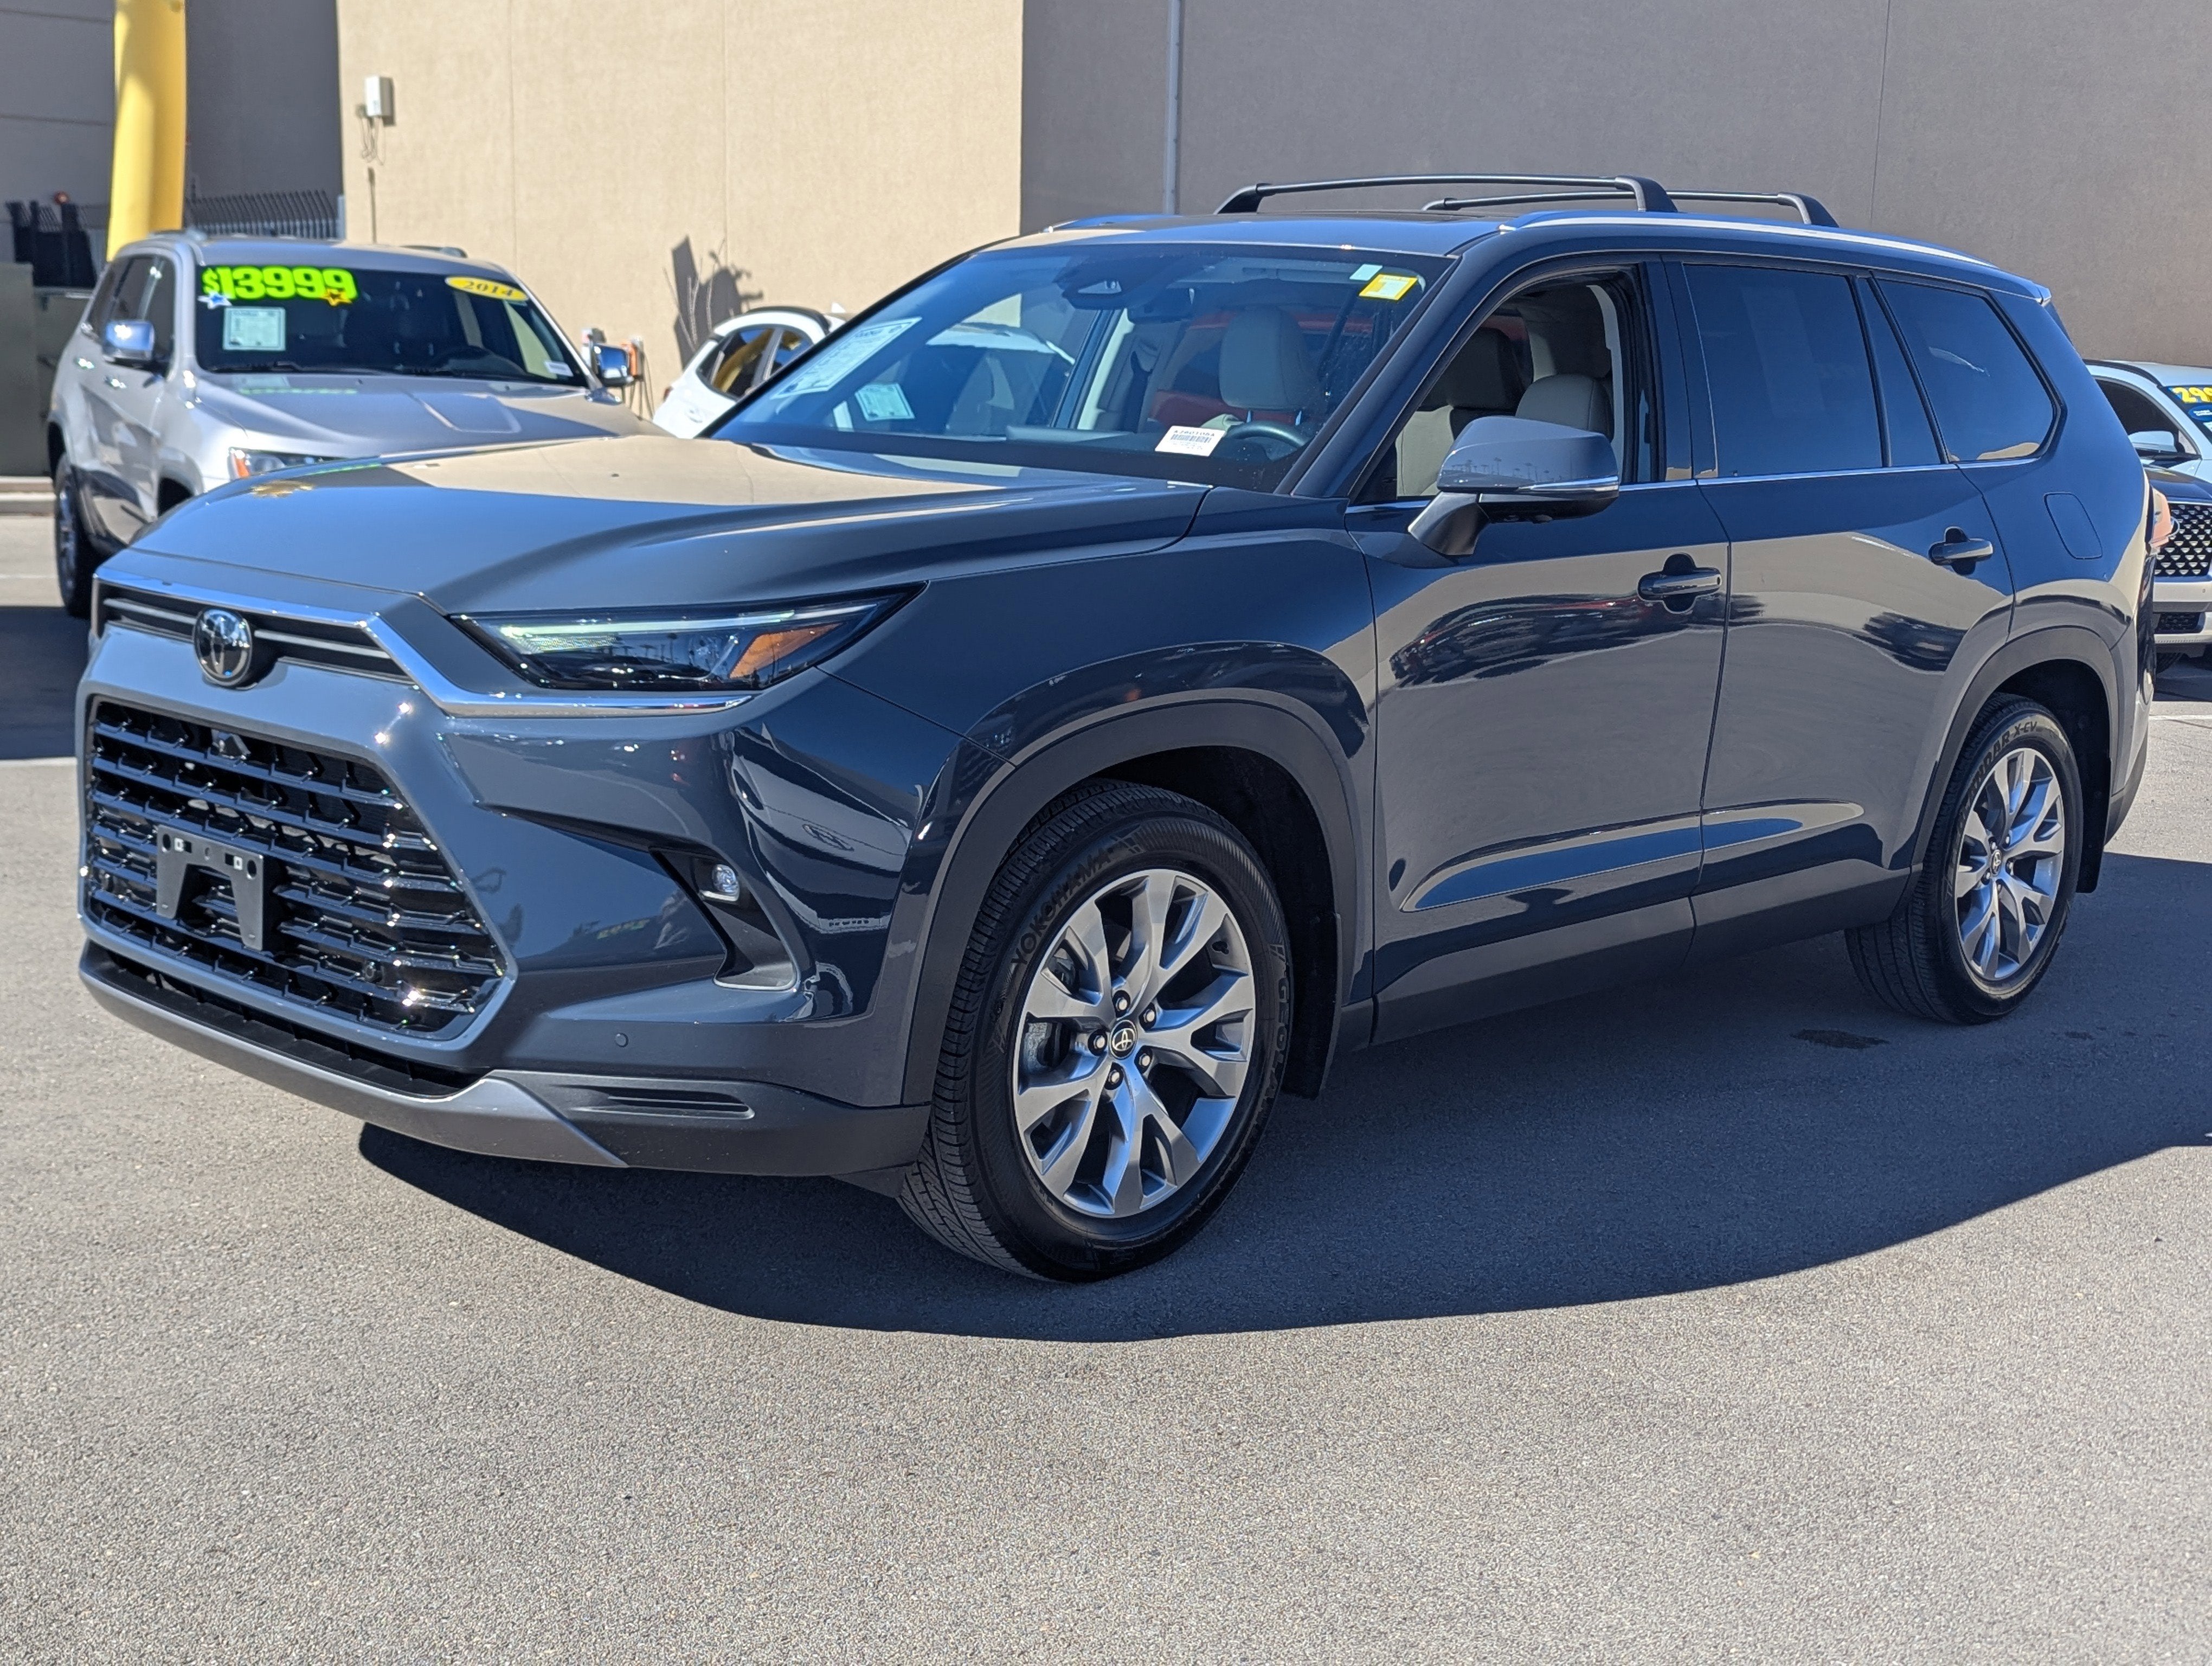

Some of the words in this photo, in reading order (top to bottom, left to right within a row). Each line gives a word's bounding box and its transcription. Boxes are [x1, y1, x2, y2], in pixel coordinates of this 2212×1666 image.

[202, 266, 358, 300] $13999
[464, 281, 513, 297] 2014
[1011, 847, 1111, 965] YOKOHAMA
